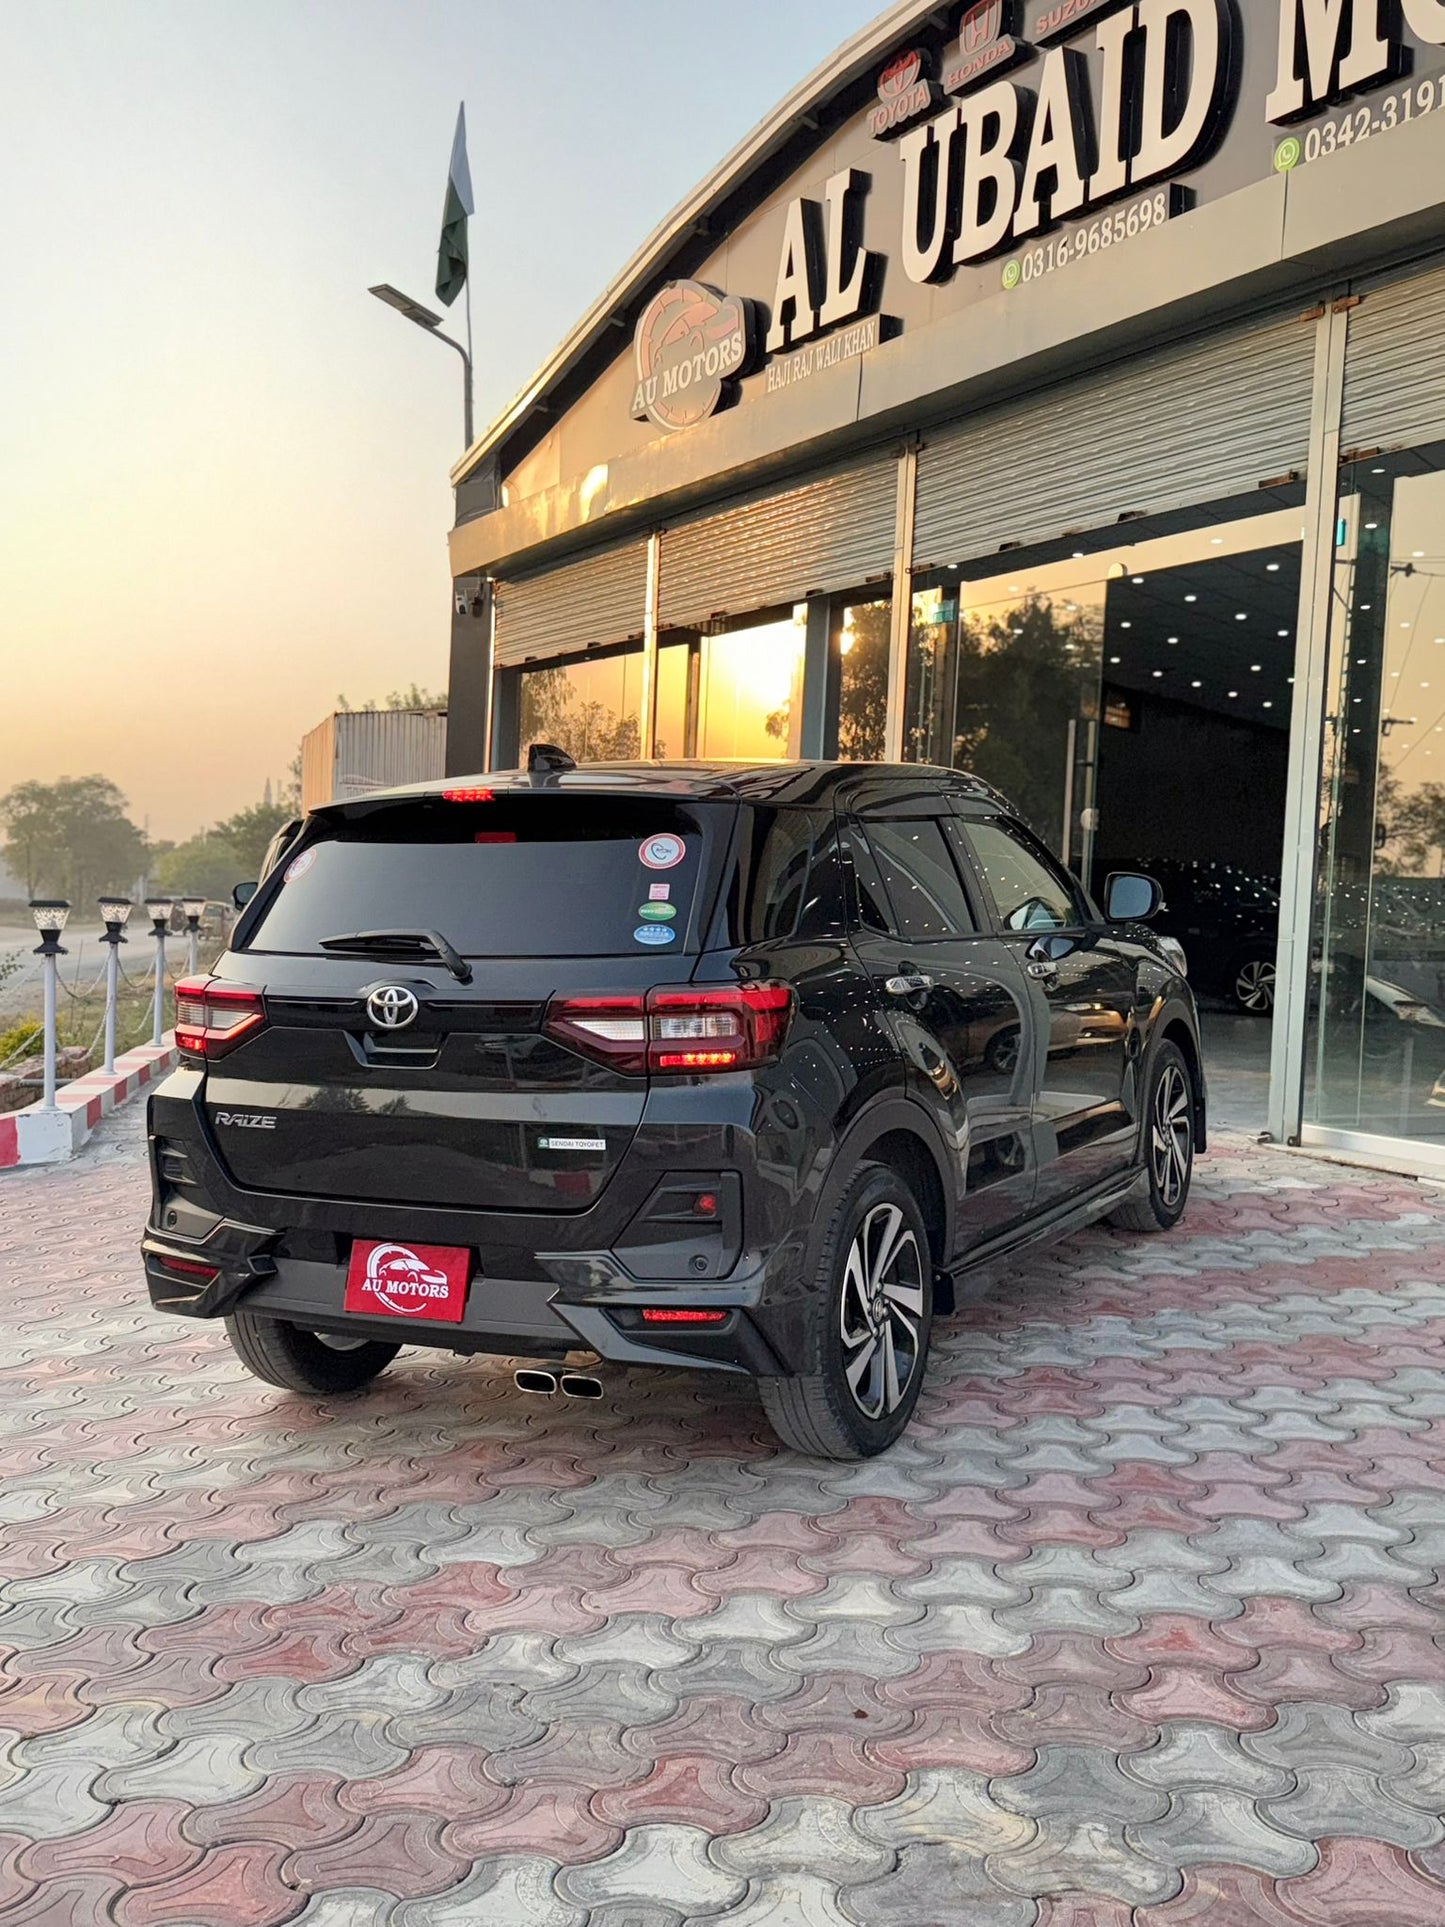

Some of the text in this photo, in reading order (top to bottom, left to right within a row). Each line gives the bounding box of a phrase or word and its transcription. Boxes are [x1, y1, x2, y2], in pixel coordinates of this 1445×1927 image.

[948, 38, 1011, 87] HONDA
[868, 86, 928, 133] TOYOTA
[765, 168, 867, 353] AL
[900, 0, 1218, 284] UBAID
[1022, 192, 1166, 282] 0316-9685698
[631, 331, 743, 411] AU MOTORS
[767, 323, 876, 393] HAJI RAJ WALI KHAN
[215, 1111, 277, 1129] RAIZE
[361, 1278, 449, 1299] AU MOTORS
